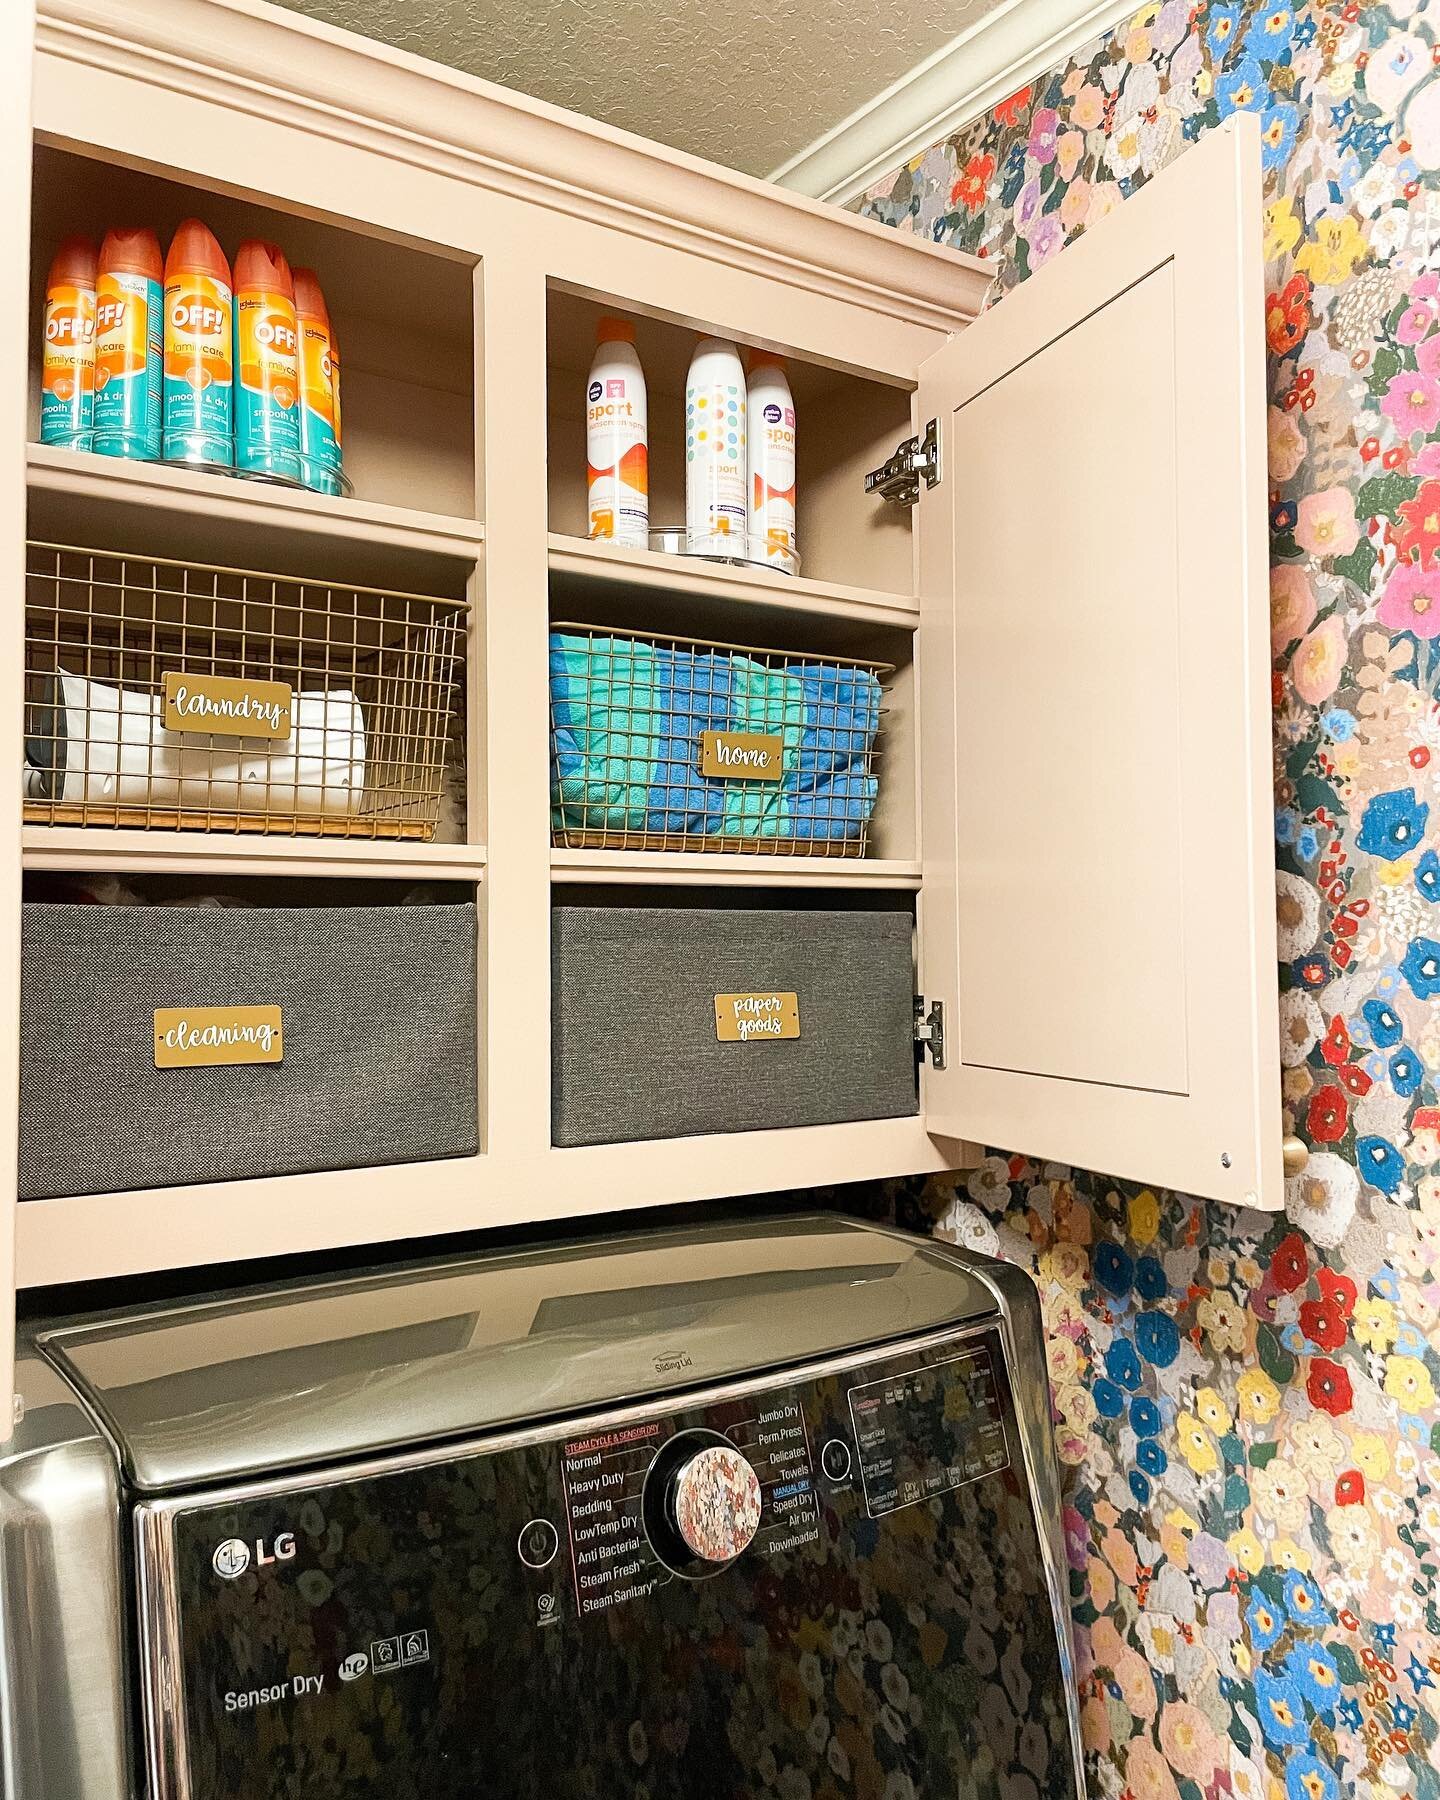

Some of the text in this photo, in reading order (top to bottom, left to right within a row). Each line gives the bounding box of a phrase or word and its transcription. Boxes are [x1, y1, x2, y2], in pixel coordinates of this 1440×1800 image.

[96, 302, 126, 328] FF!
[171, 305, 225, 335] OFF!
[589, 402, 632, 421] sport
[176, 686, 285, 730] laundry
[716, 738, 772, 768] home
[733, 996, 783, 1019] paper
[165, 1020, 275, 1052] cleaning
[737, 1014, 783, 1041] goods
[655, 1357, 693, 1373] Sliding Lid
[758, 1406, 798, 1424] Jumbo Dry
[565, 1423, 660, 1454] STEAM CYCLE & SENSOR DRY
[566, 1453, 602, 1472] Normal
[770, 1447, 806, 1464] Delicates
[780, 1464, 809, 1480] Towels
[569, 1472, 625, 1495] Heavy Duty
[773, 1480, 810, 1497] MANUAL DRY
[904, 1481, 916, 1493] Dry
[773, 1493, 813, 1513] Speed Dry
[903, 1487, 920, 1502] Level
[572, 1499, 612, 1518] Bedding
[621, 1515, 638, 1529] Dry
[789, 1510, 816, 1527] Air Dry
[257, 1533, 297, 1566] LG
[769, 1527, 819, 1553] Downloaded
[577, 1536, 640, 1565] Anti Bacterial
[580, 1569, 612, 1588] Steam
[583, 1594, 613, 1612] Steam
[224, 1674, 324, 1711] Sensor Dry
